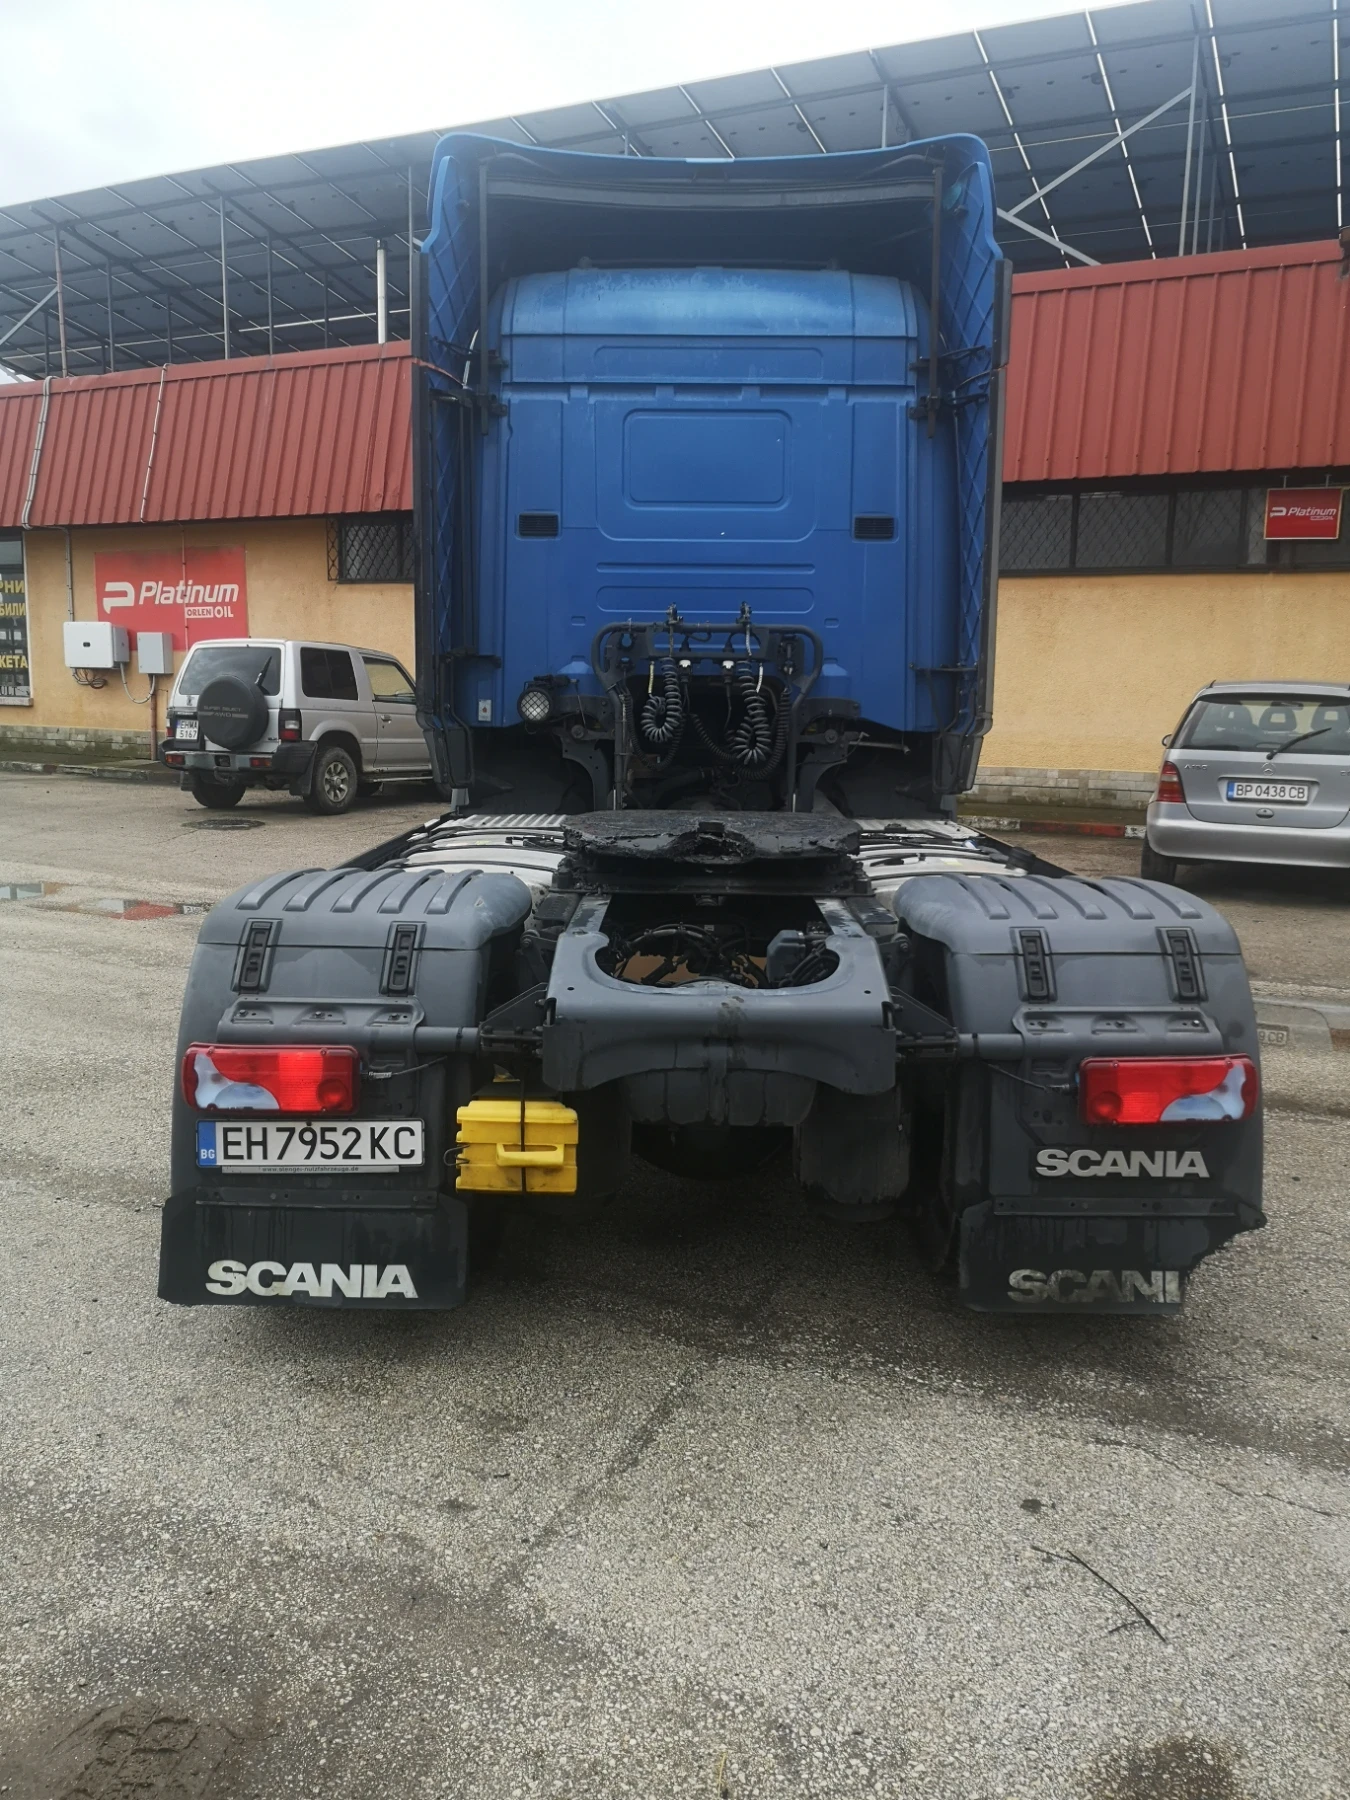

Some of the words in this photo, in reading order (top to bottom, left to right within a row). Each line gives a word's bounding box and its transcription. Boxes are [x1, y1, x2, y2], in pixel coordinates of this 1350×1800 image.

[1287, 506, 1337, 516] Platinum
[138, 580, 239, 604] Platinum
[186, 608, 212, 617] ORLEN
[214, 606, 233, 618] OIL
[180, 729, 197, 738] 5167
[1235, 784, 1252, 796] BP
[1255, 785, 1286, 798] 0438
[1288, 786, 1305, 799] CB
[200, 1149, 216, 1160] BG
[1035, 1148, 1210, 1178] SCANIA
[205, 1258, 419, 1299] SCANIA
